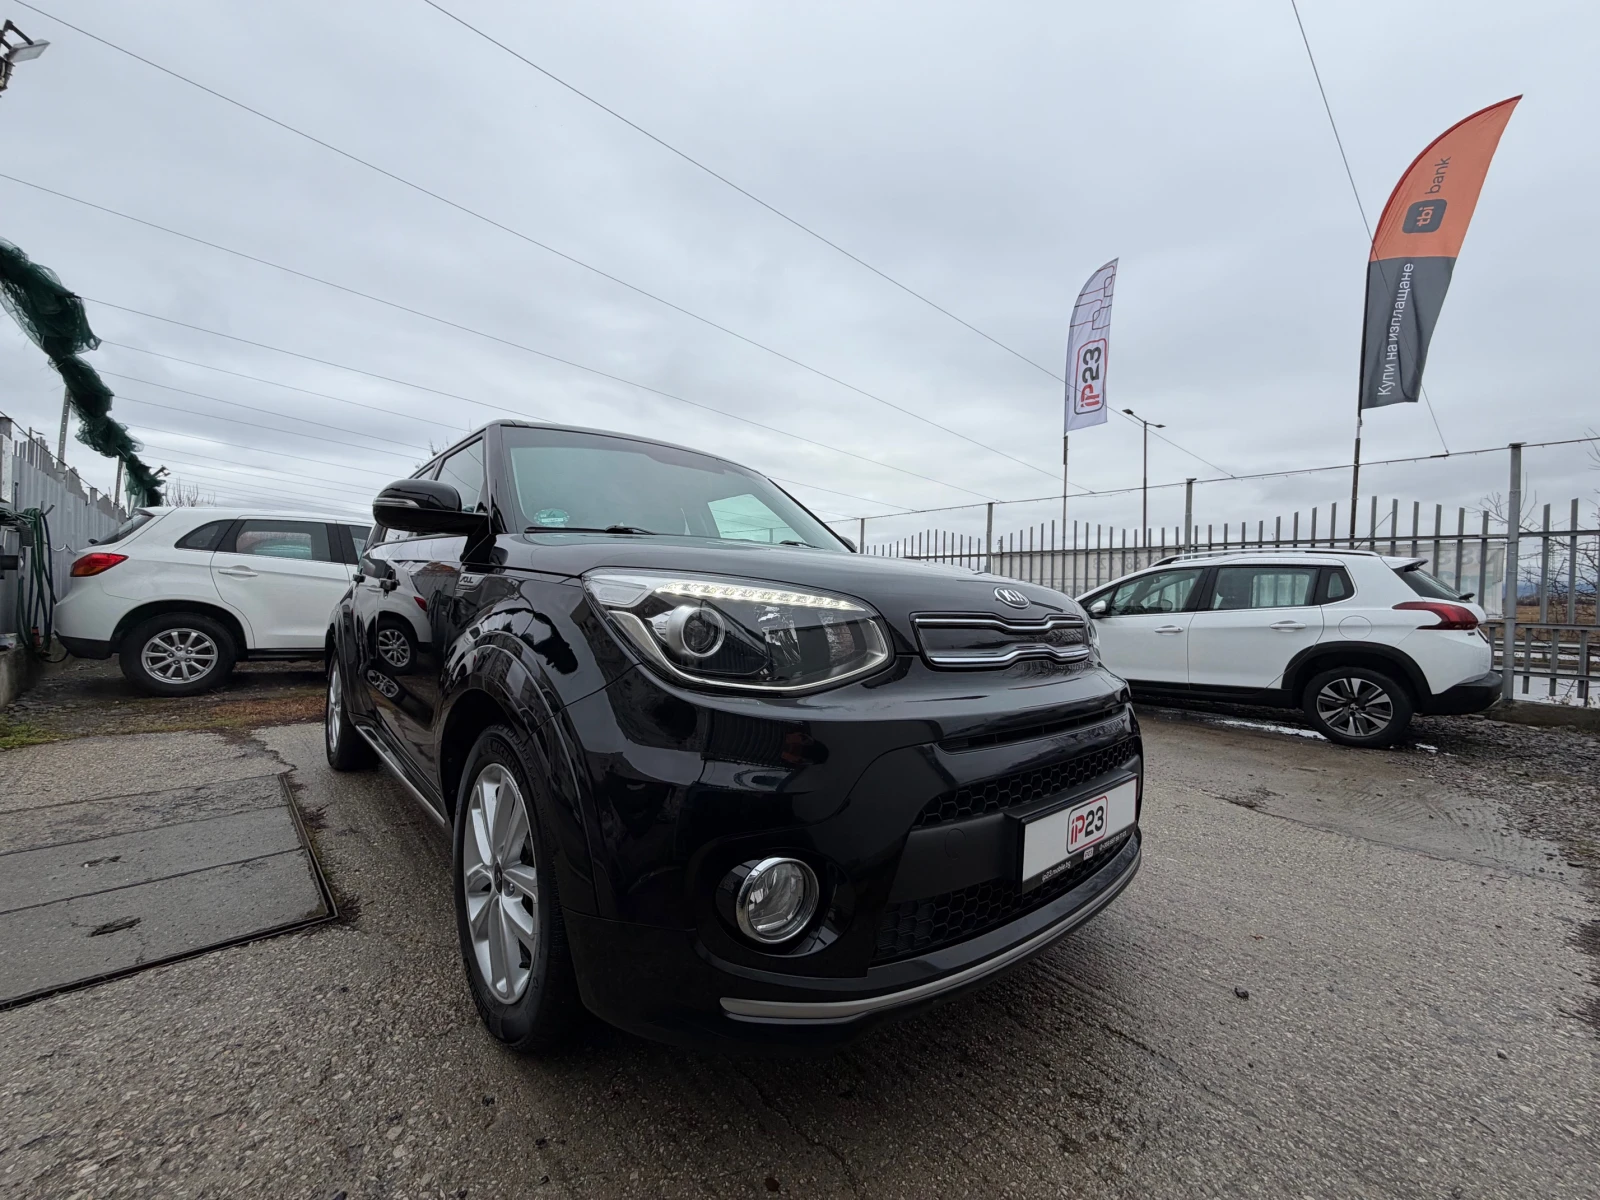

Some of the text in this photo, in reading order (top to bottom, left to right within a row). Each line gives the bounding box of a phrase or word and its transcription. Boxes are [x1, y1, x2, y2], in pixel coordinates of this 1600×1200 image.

[1416, 156, 1452, 227] tbi bank
[1377, 262, 1414, 396] Купи на изплащане
[998, 589, 1028, 602] KIA
